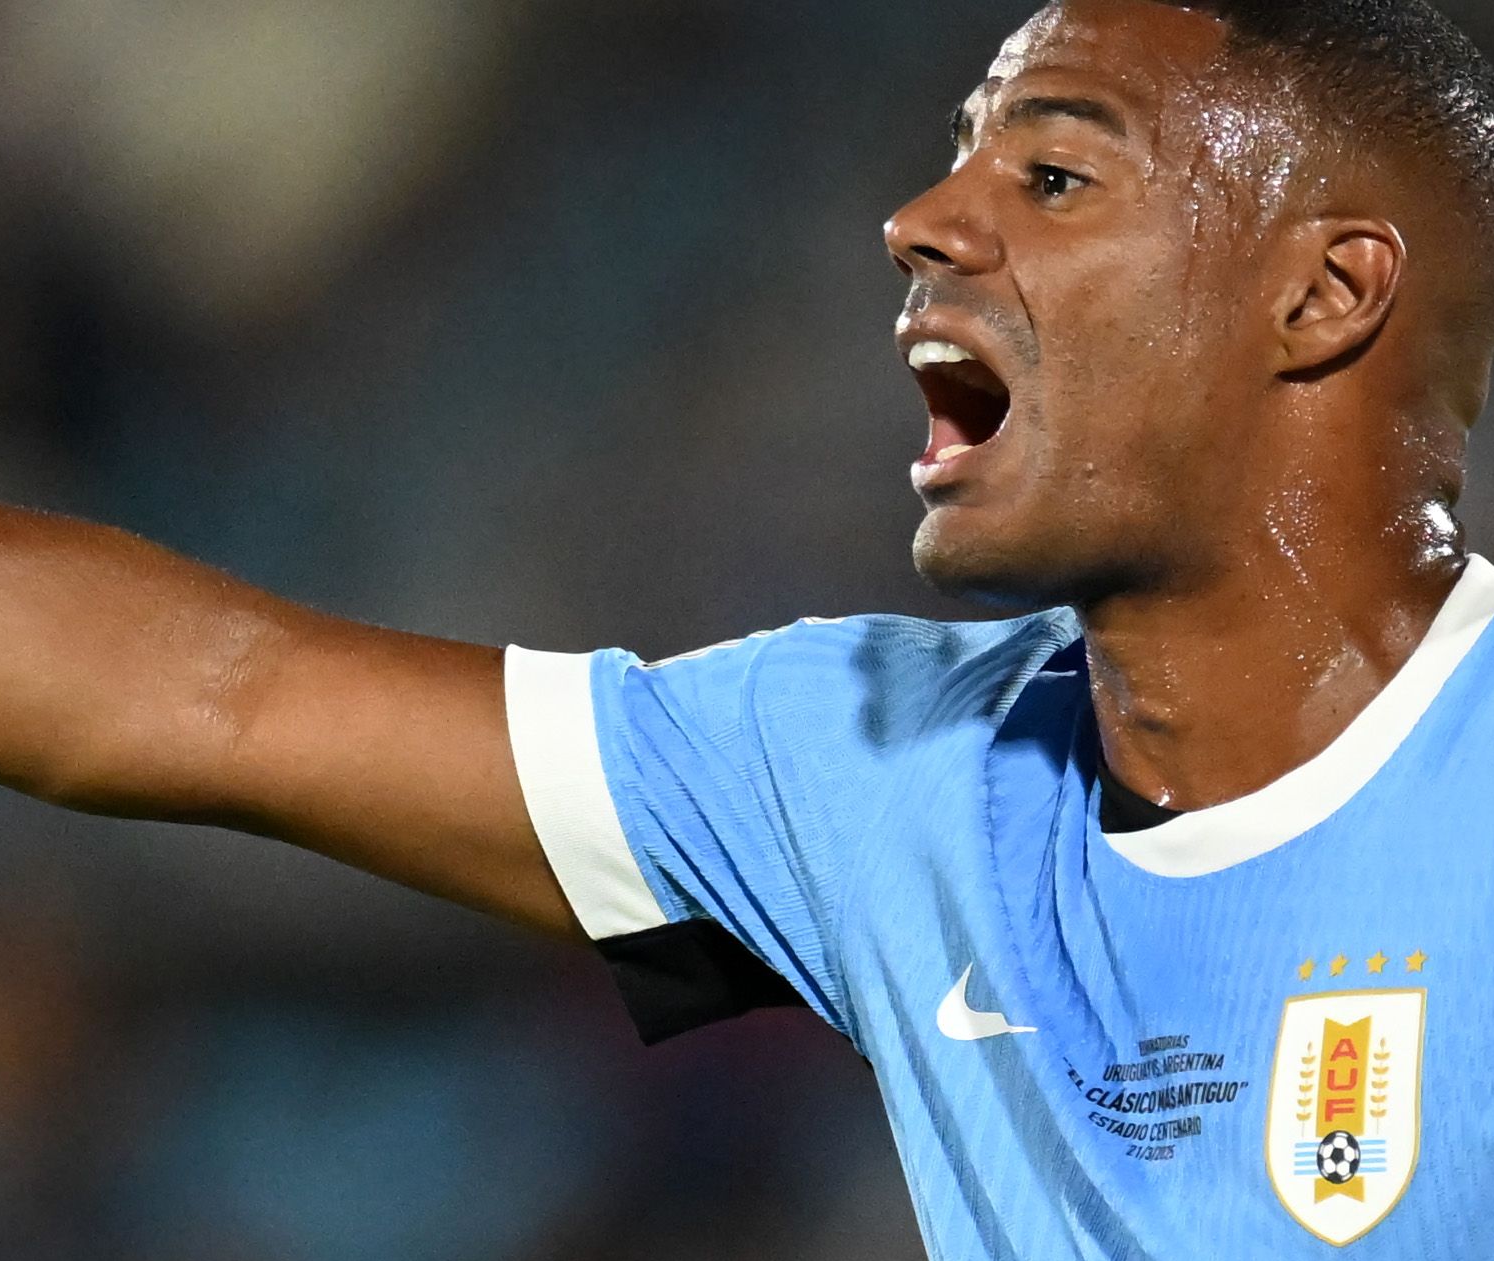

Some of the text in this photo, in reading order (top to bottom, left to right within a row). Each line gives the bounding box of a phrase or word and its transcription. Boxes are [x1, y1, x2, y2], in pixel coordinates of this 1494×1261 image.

[1103, 1060, 1150, 1082] URUGUAY
[1163, 1053, 1225, 1074] ARGENTINA
[1325, 1038, 1358, 1122] AUF
[1085, 1087, 1157, 1113] CLÁSICO
[1088, 1111, 1202, 1142] ESTADIO CENTENARIO
